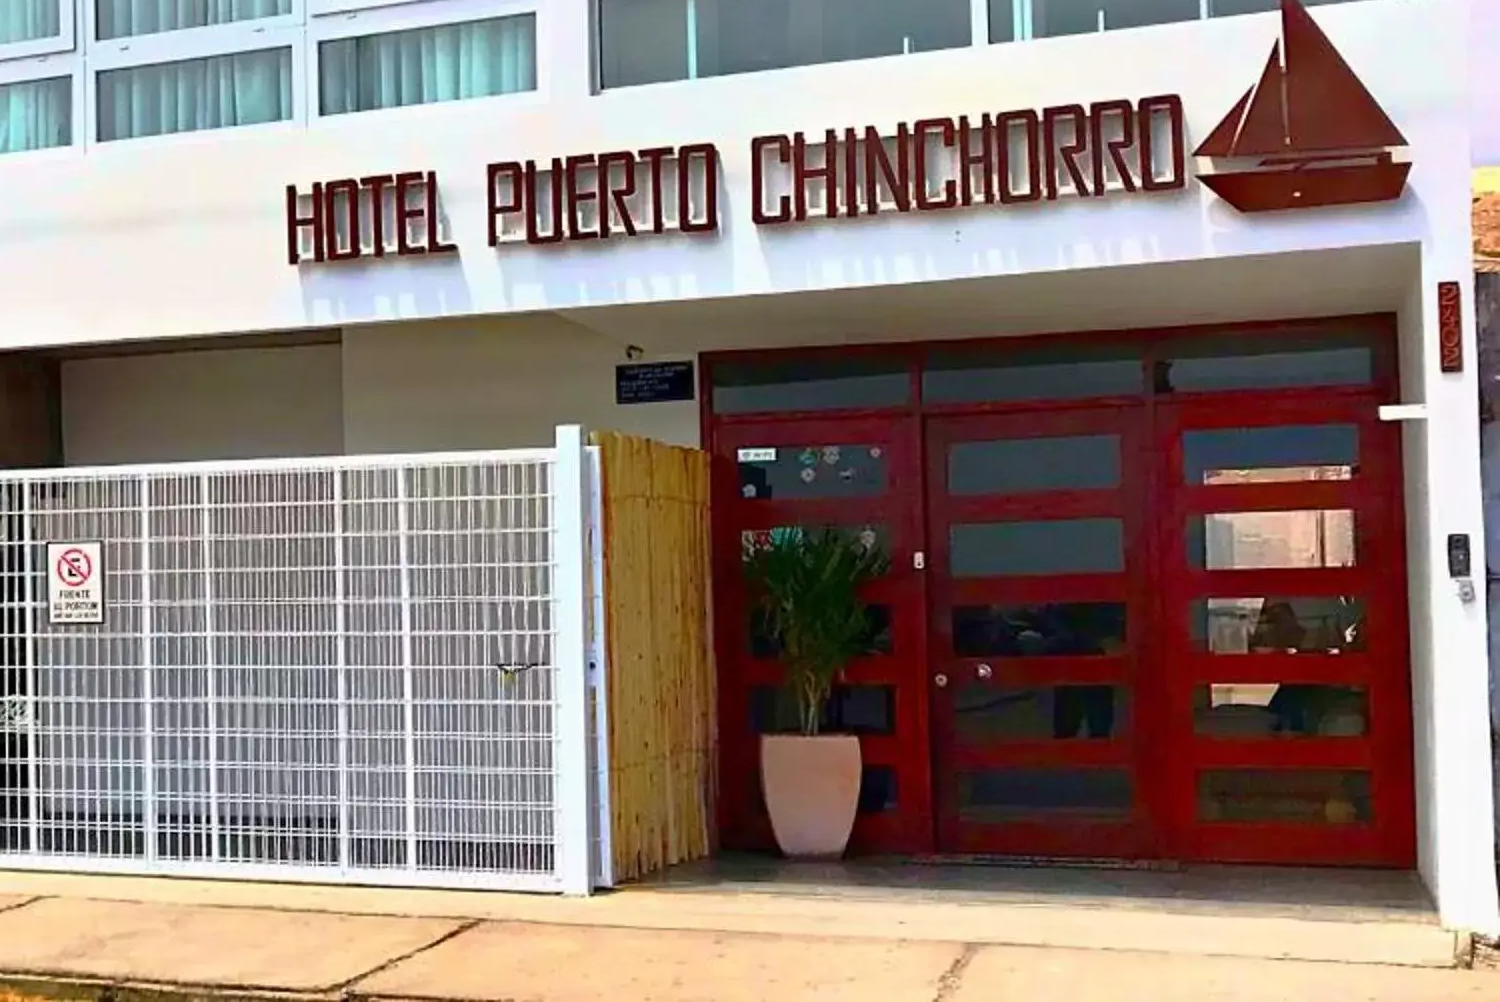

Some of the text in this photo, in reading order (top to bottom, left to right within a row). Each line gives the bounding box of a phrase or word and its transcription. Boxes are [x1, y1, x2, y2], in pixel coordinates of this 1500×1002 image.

[285, 93, 1186, 265] HOTEL PUERTO CHINCHORRO
